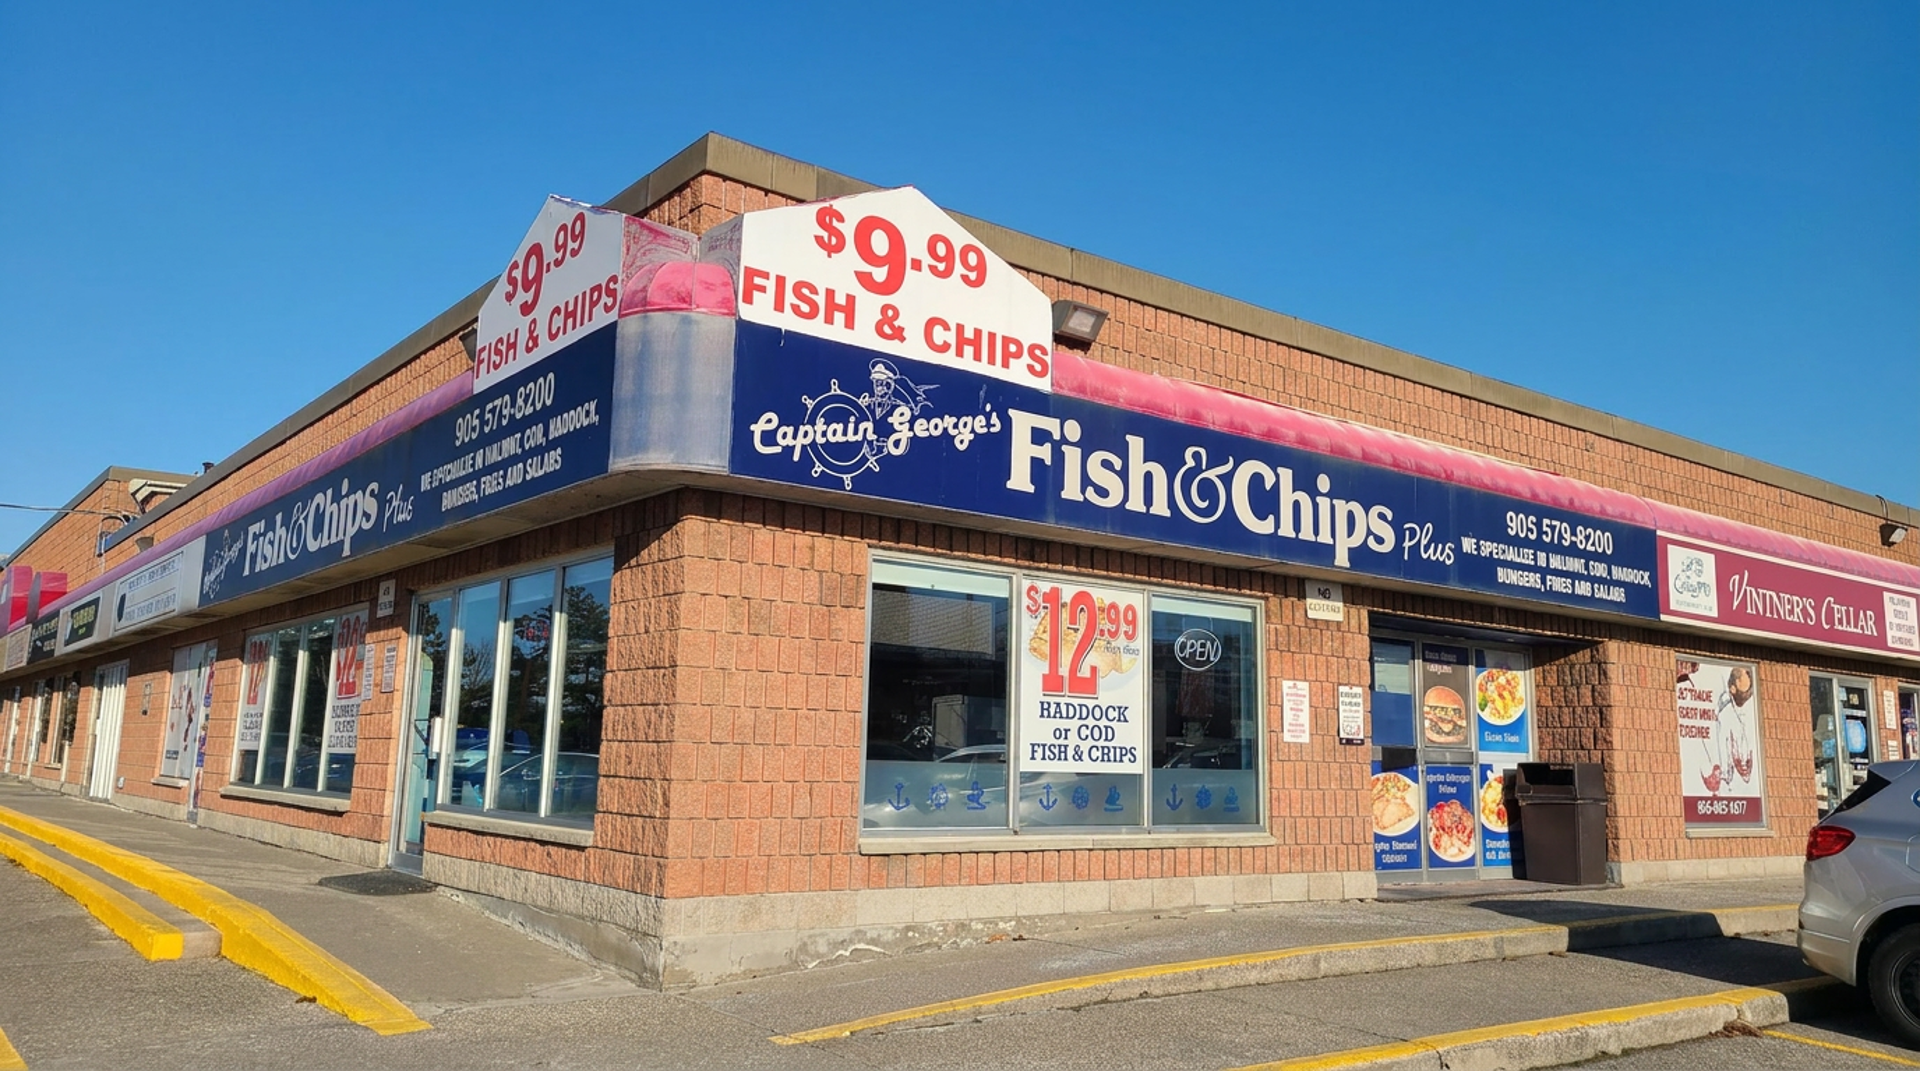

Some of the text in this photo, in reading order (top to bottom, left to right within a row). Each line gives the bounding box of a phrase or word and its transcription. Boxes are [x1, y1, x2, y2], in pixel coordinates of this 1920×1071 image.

[505, 212, 586, 316] $9.99
[814, 204, 987, 296] $9.99
[476, 274, 619, 380] FISH & CHIPS
[742, 266, 1049, 378] FISH & CHIPS
[456, 371, 555, 446] 905 579-8200
[750, 403, 1001, 461] Captain George's
[243, 511, 287, 577] Fish
[286, 499, 312, 560] &
[306, 478, 379, 557] Chips
[1006, 408, 1454, 568] Fish & Chips Plus
[1461, 536, 1478, 555] WE
[1506, 511, 1613, 555] 905 579-8200
[1026, 584, 1138, 696] $12.99
[1177, 636, 1218, 661] OPEN
[1029, 743, 1069, 761] FISH
[1072, 744, 1084, 762] &
[1053, 724, 1115, 742] or COD
